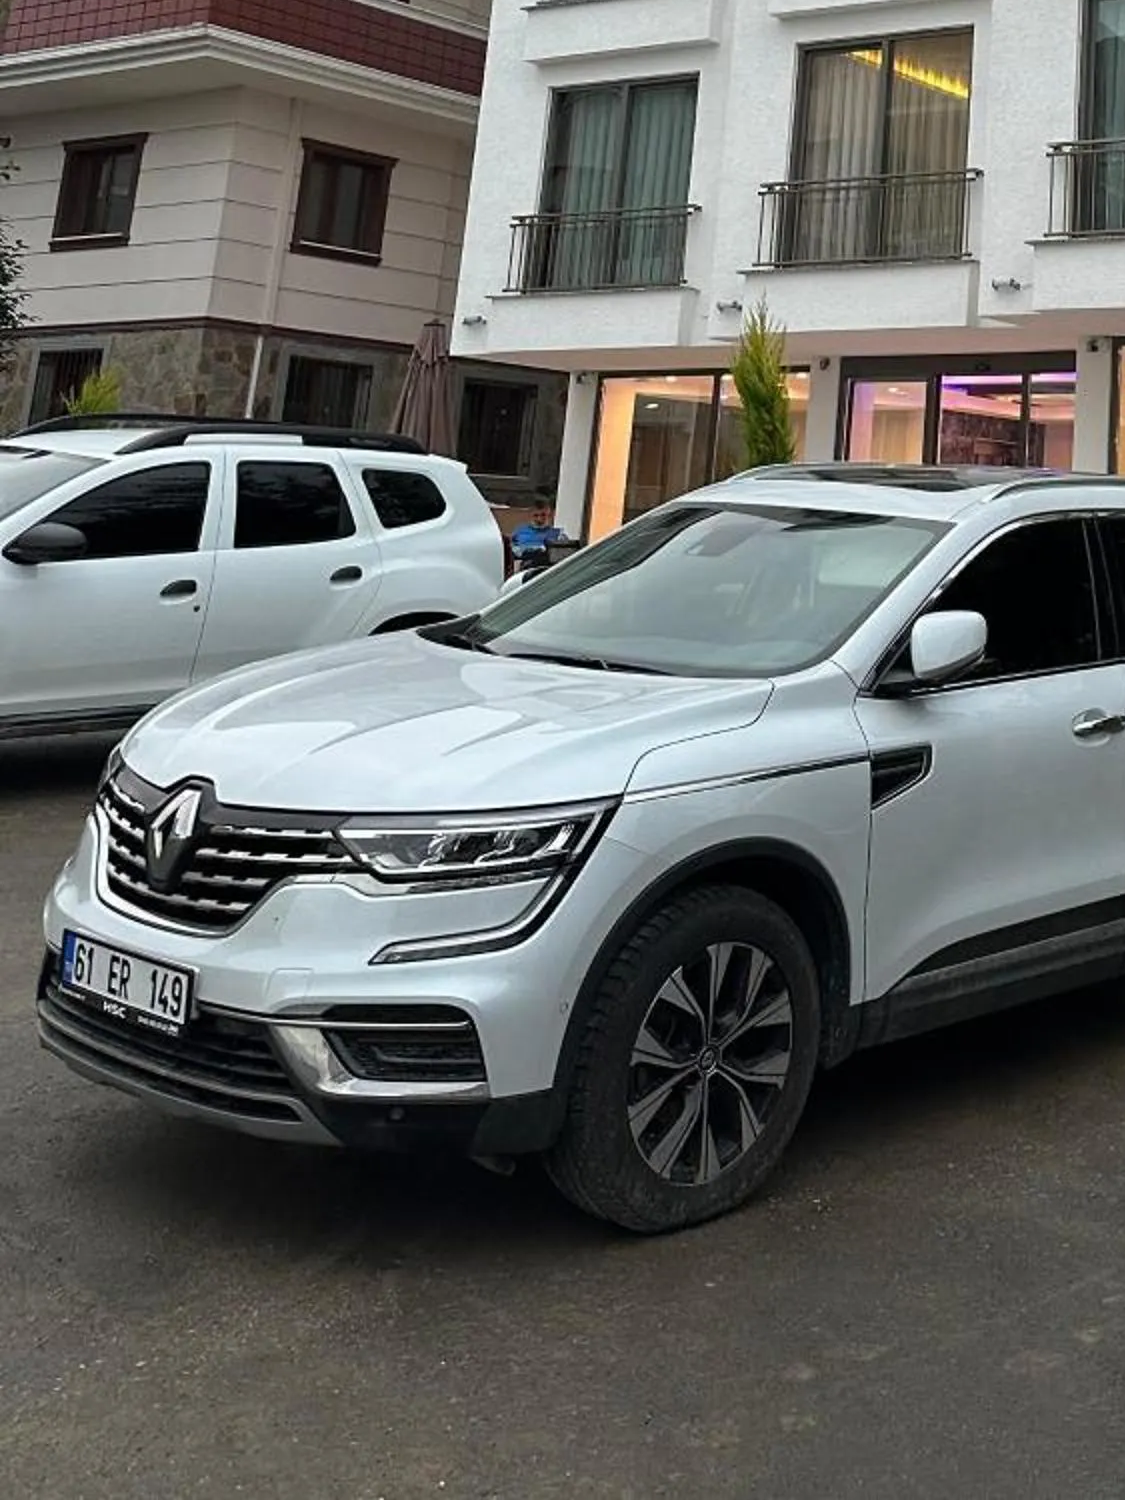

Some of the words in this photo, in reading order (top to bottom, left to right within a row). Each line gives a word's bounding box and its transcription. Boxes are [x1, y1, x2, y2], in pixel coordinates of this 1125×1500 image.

[75, 943, 94, 985] 61
[108, 956, 131, 1000] ER
[151, 970, 183, 1018] 149
